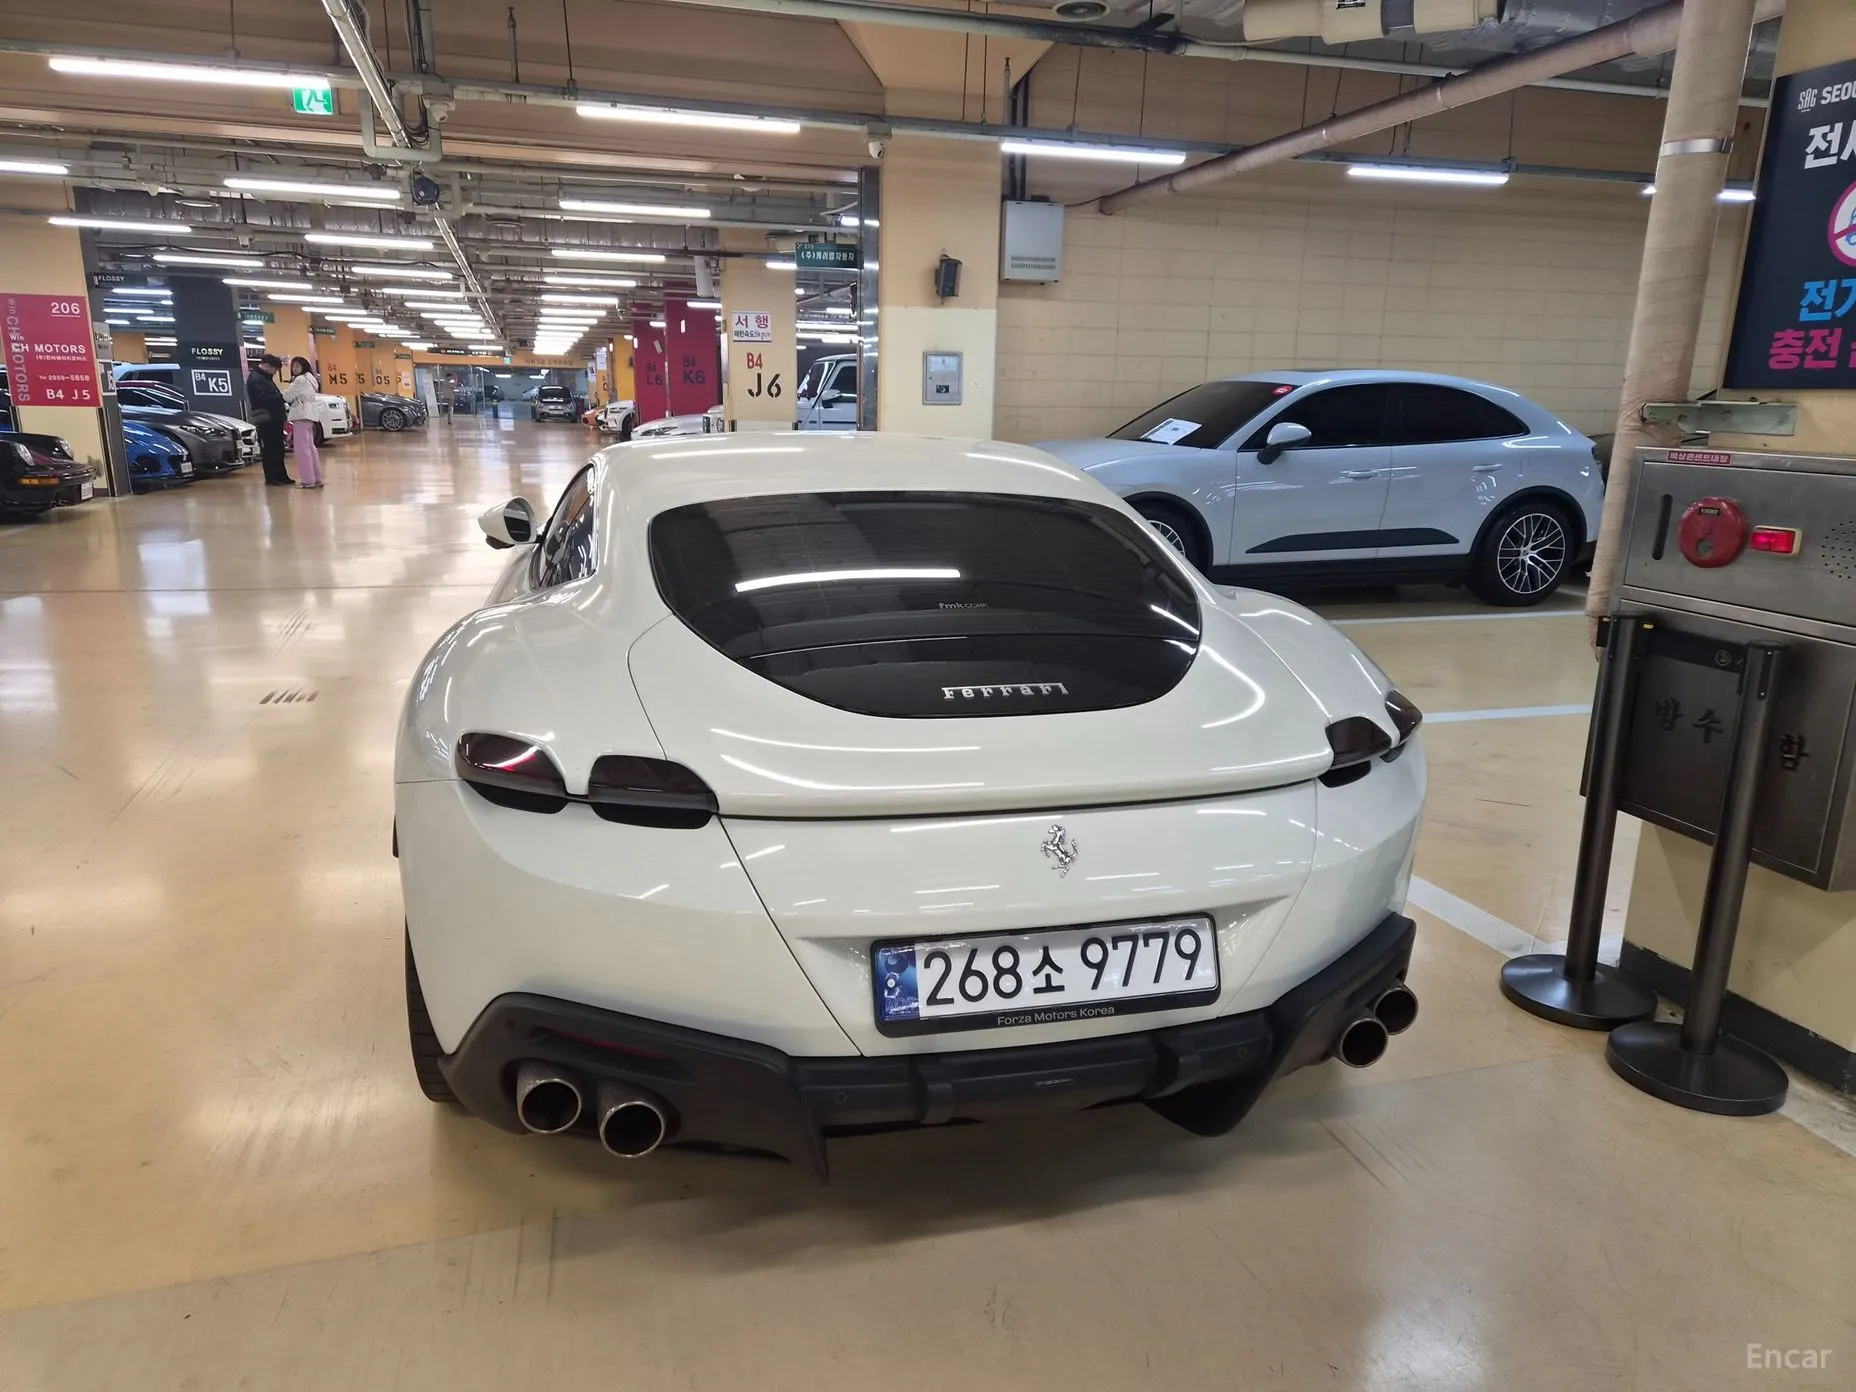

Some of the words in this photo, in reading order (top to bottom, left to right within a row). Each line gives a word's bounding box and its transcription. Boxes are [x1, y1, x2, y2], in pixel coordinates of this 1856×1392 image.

[51, 302, 80, 315] 206
[34, 344, 86, 354] MOTORS
[191, 347, 224, 356] FLOSSY
[1768, 327, 1842, 370] 충전
[683, 356, 696, 367] B4
[747, 352, 763, 369] B4
[195, 372, 206, 382] B4
[328, 373, 348, 385] M5
[646, 374, 663, 386] L6
[683, 370, 705, 384] K6
[208, 377, 229, 393] K5
[747, 373, 782, 398] J6
[46, 388, 65, 400] B4
[941, 682, 1069, 700] Ferrari
[923, 945, 1066, 1007] 268소
[1080, 928, 1202, 991] 9779
[997, 1014, 1033, 1026] Forza
[1034, 1009, 1078, 1022] Motors
[1079, 1004, 1116, 1019] Korea
